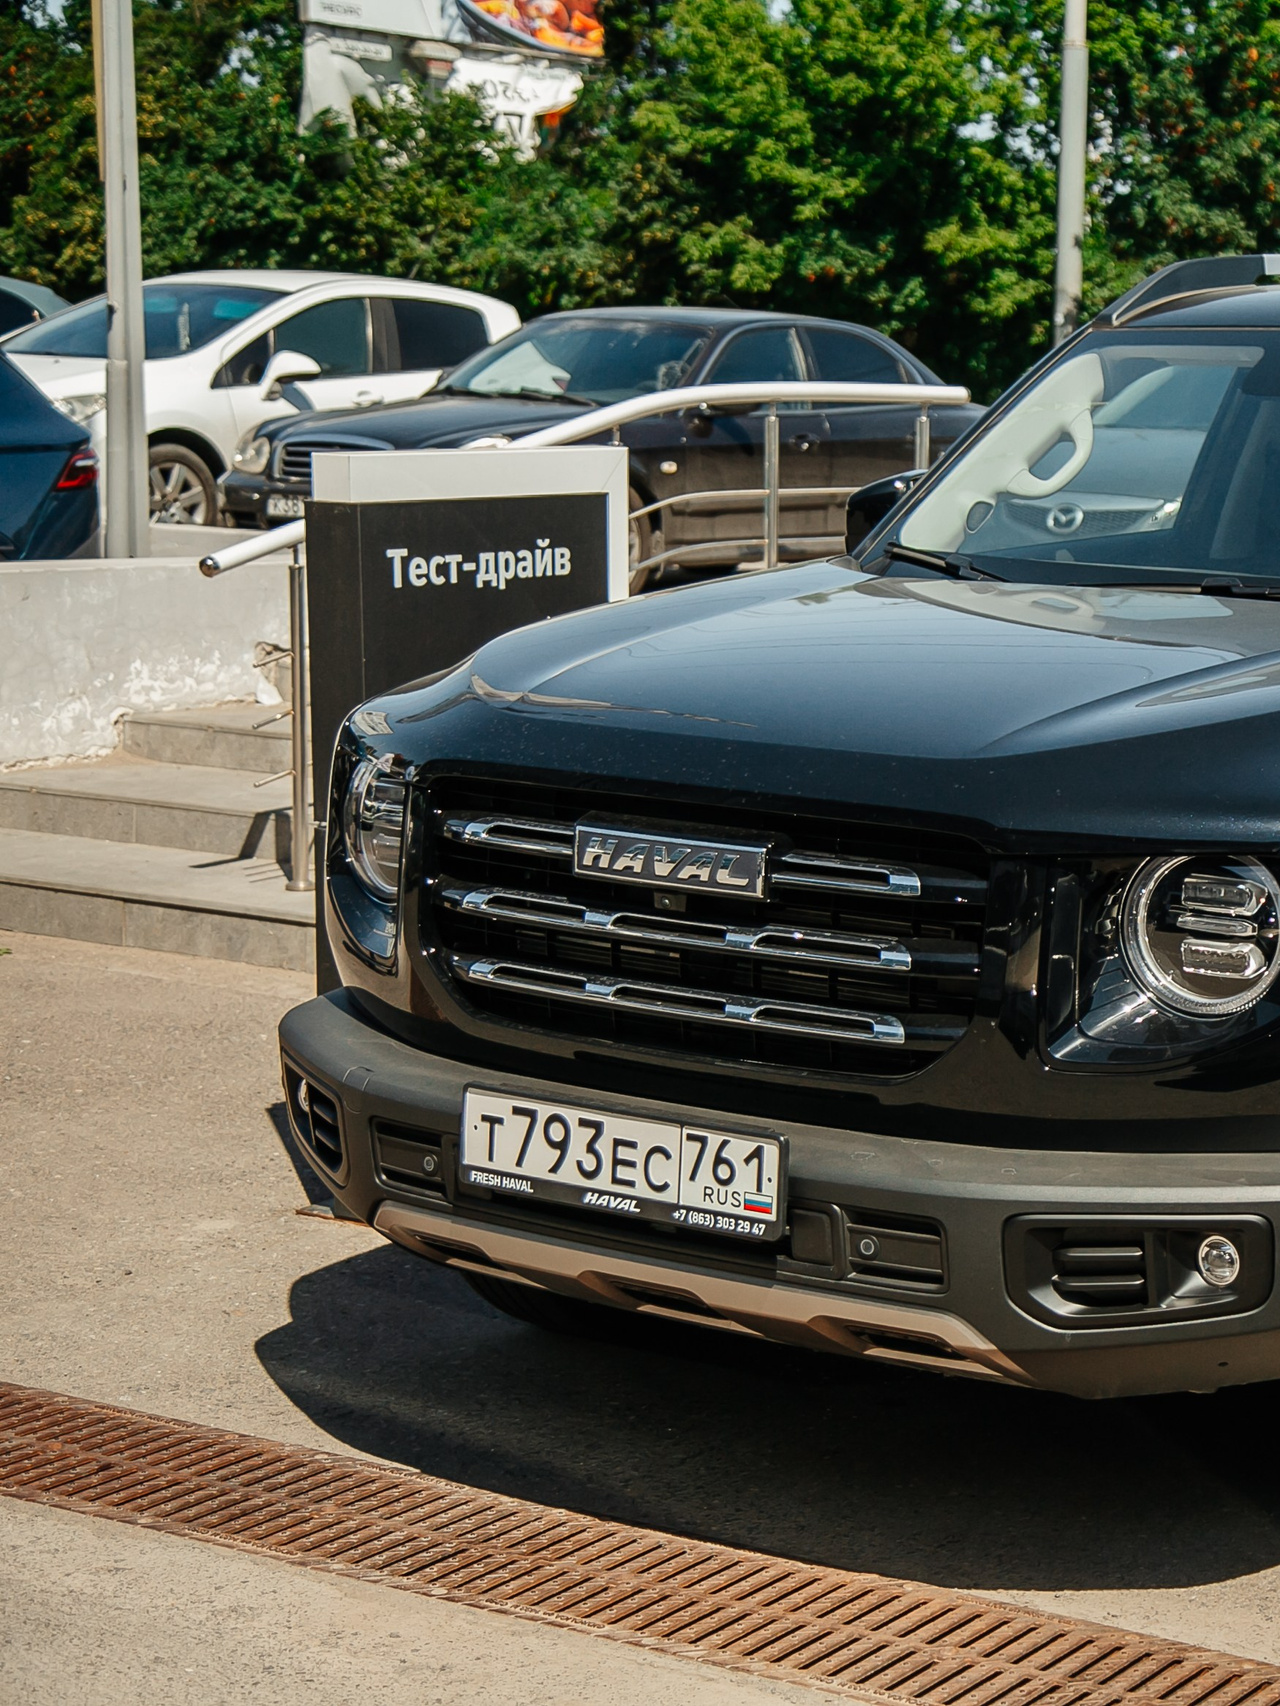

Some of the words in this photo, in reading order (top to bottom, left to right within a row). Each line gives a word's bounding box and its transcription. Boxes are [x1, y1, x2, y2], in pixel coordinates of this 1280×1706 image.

[386, 538, 571, 590] Тест-драйв
[582, 836, 749, 887] HAVAL
[686, 1132, 765, 1193] 761
[471, 1170, 501, 1187] FRESH
[502, 1176, 534, 1193] HAVAL
[584, 1191, 641, 1213] HAVAL
[703, 1186, 742, 1208] RUS
[672, 1209, 687, 1221] +7
[688, 1210, 715, 1228] (863)
[716, 1216, 736, 1230] 303
[737, 1219, 751, 1233] 29
[752, 1222, 766, 1236] 47
